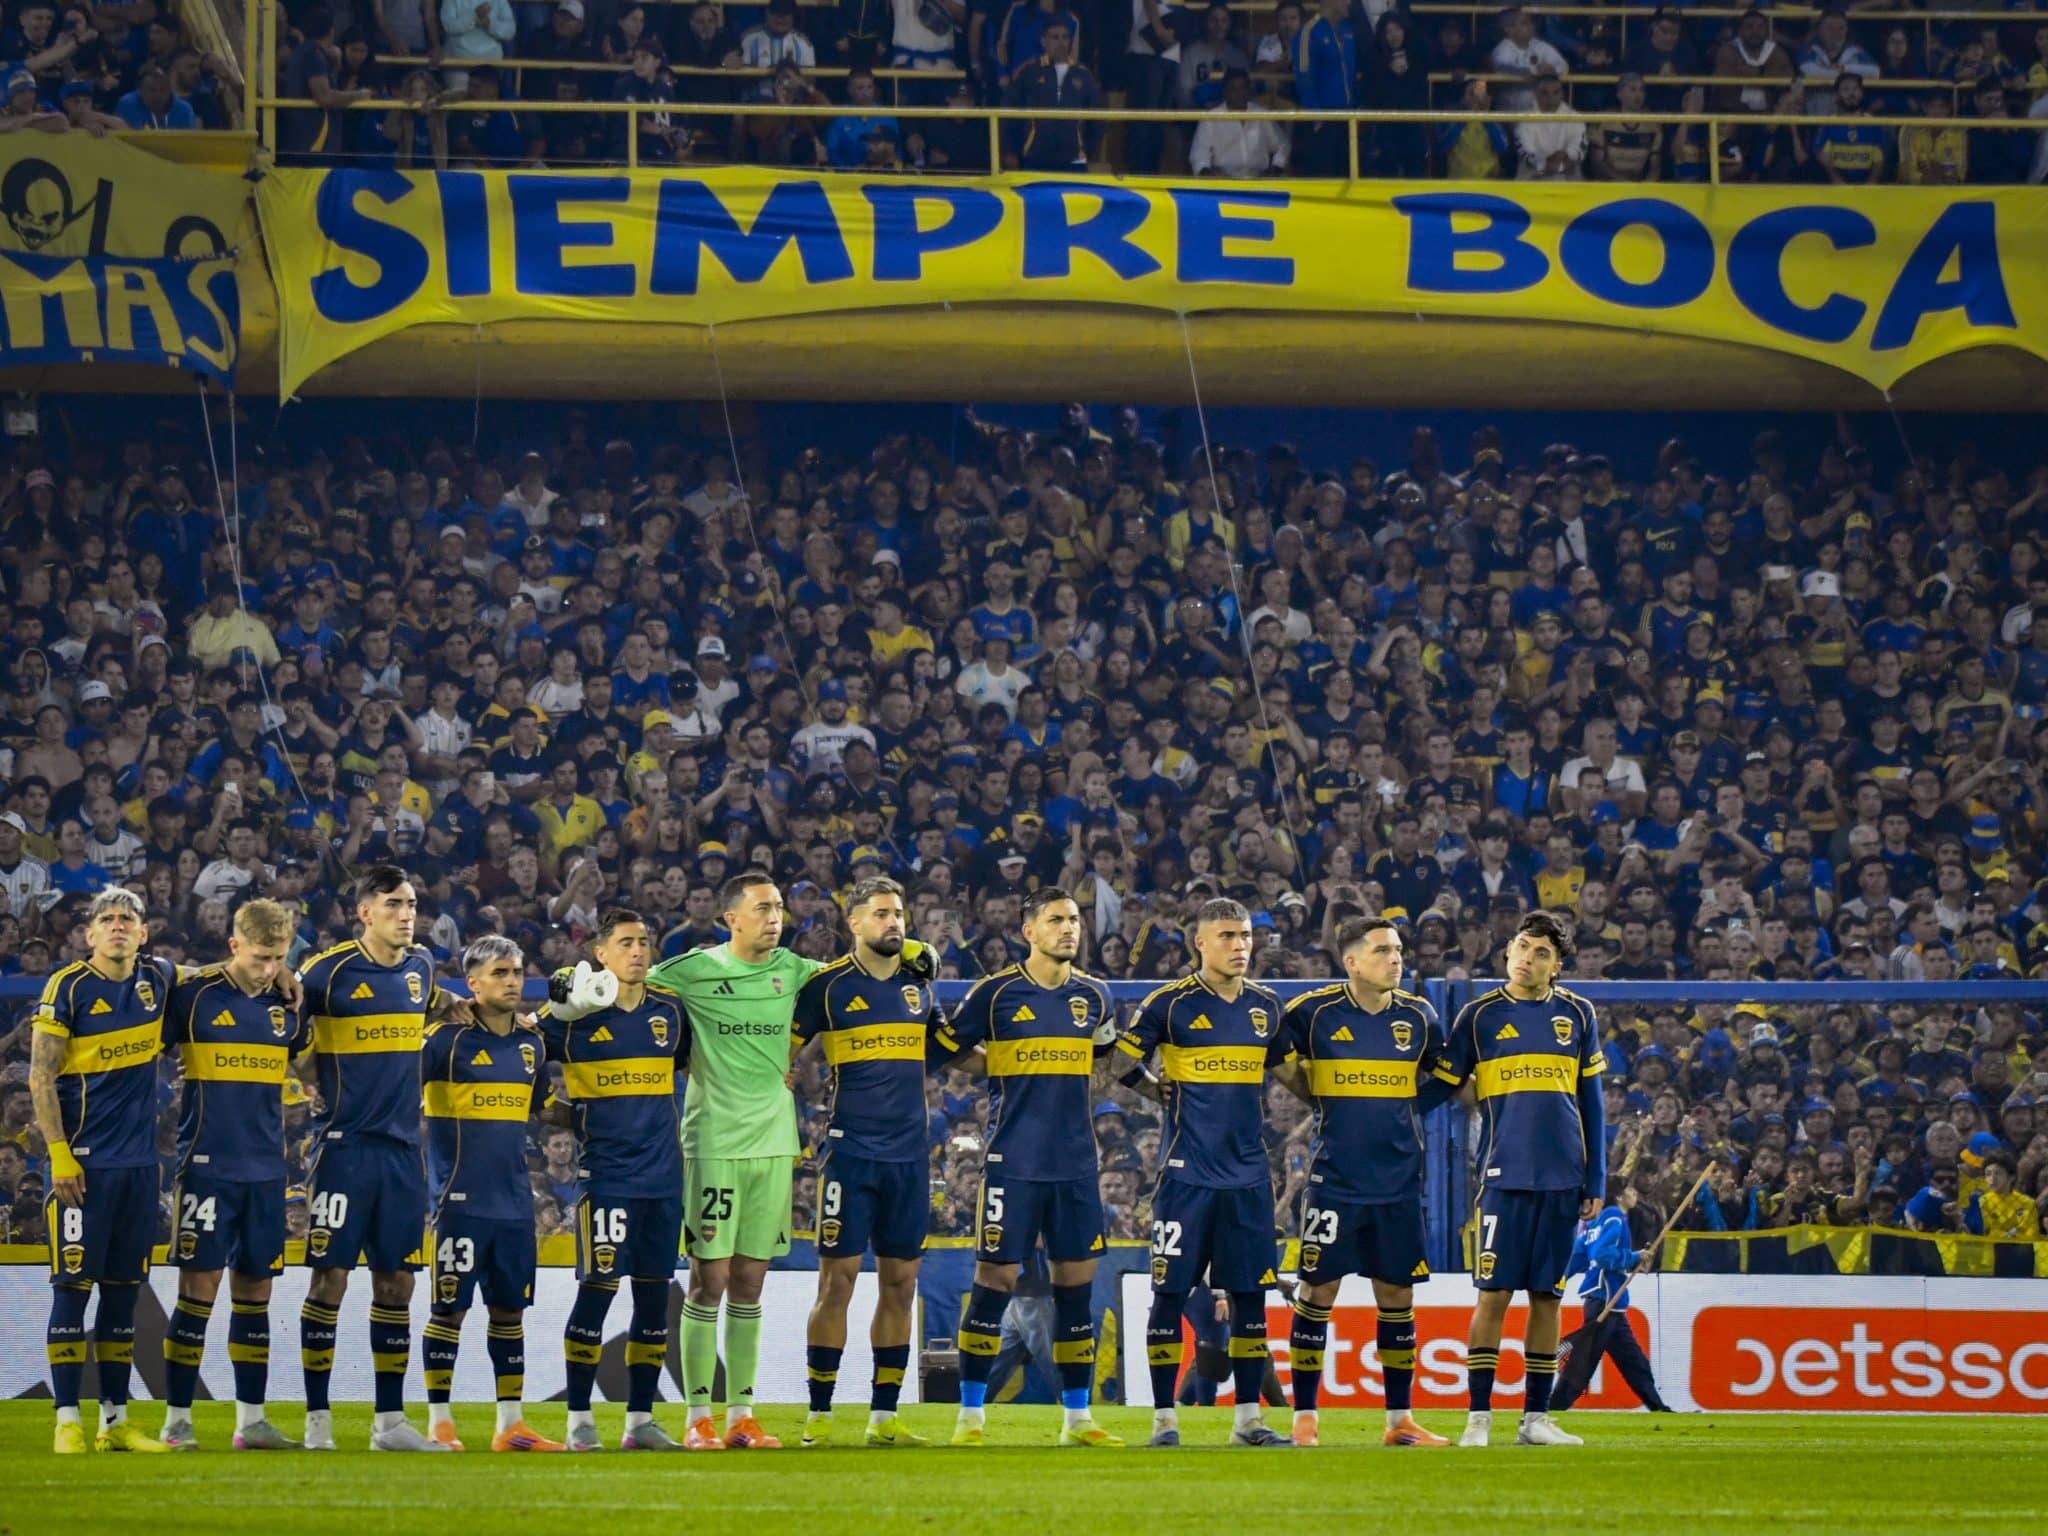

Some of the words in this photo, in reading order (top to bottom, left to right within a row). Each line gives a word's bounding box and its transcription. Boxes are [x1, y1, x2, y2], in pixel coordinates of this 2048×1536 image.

[310, 168, 1294, 323] SIEMPRE
[1392, 192, 2018, 352] BOCA
[0, 258, 237, 372] MAS
[1016, 1046, 1087, 1062] betsson
[1334, 1070, 1408, 1087] betsson
[181, 1193, 217, 1231] 24
[310, 1191, 348, 1229] 40
[701, 1187, 735, 1220] 25
[824, 1181, 842, 1215] 9
[986, 1187, 1004, 1221] 5
[64, 1208, 83, 1242] 8
[593, 1208, 628, 1243] 16
[1152, 1220, 1182, 1256] 32
[1304, 1208, 1339, 1244] 23
[1483, 1215, 1498, 1250] 7
[438, 1237, 475, 1272] 43
